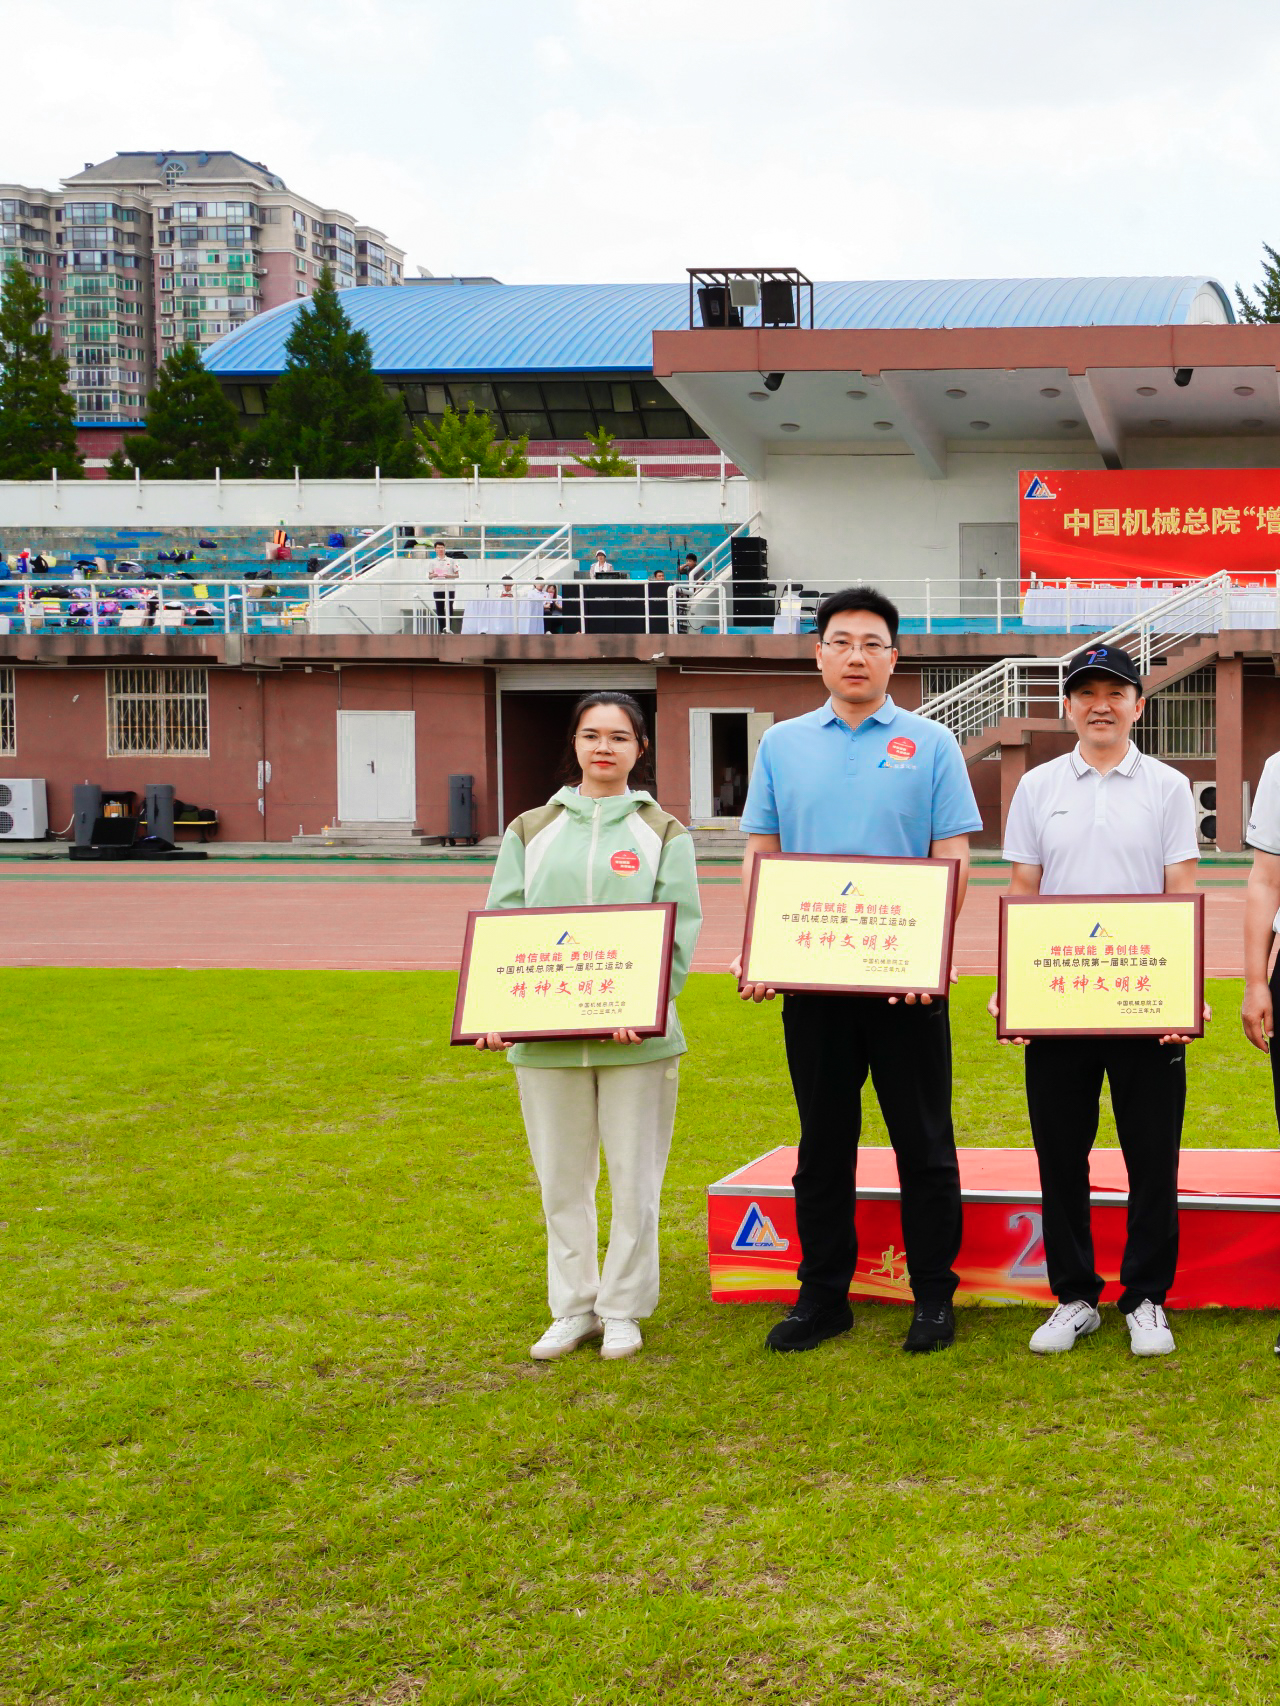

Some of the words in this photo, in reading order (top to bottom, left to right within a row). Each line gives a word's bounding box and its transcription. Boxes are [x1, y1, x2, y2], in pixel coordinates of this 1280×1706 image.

[800, 902, 847, 914] 增信赋能
[855, 904, 901, 915] 勇创佳绩
[782, 913, 917, 927] 中国机械总院第一届职工运动会
[795, 930, 898, 952] 精神文明奖
[515, 952, 563, 964] 增信赋能
[570, 950, 618, 962] 勇创佳绩
[1050, 945, 1098, 956] 增信赋能
[1105, 944, 1151, 956] 勇创佳绩
[496, 961, 634, 975] 中国机械总院第一届职工运动会
[1033, 957, 1168, 968] 中国机械总院第一届职工运动会
[510, 979, 616, 999] 精神文明奖
[1049, 974, 1152, 994] 精神文明奖
[1009, 1212, 1046, 1279] 2
